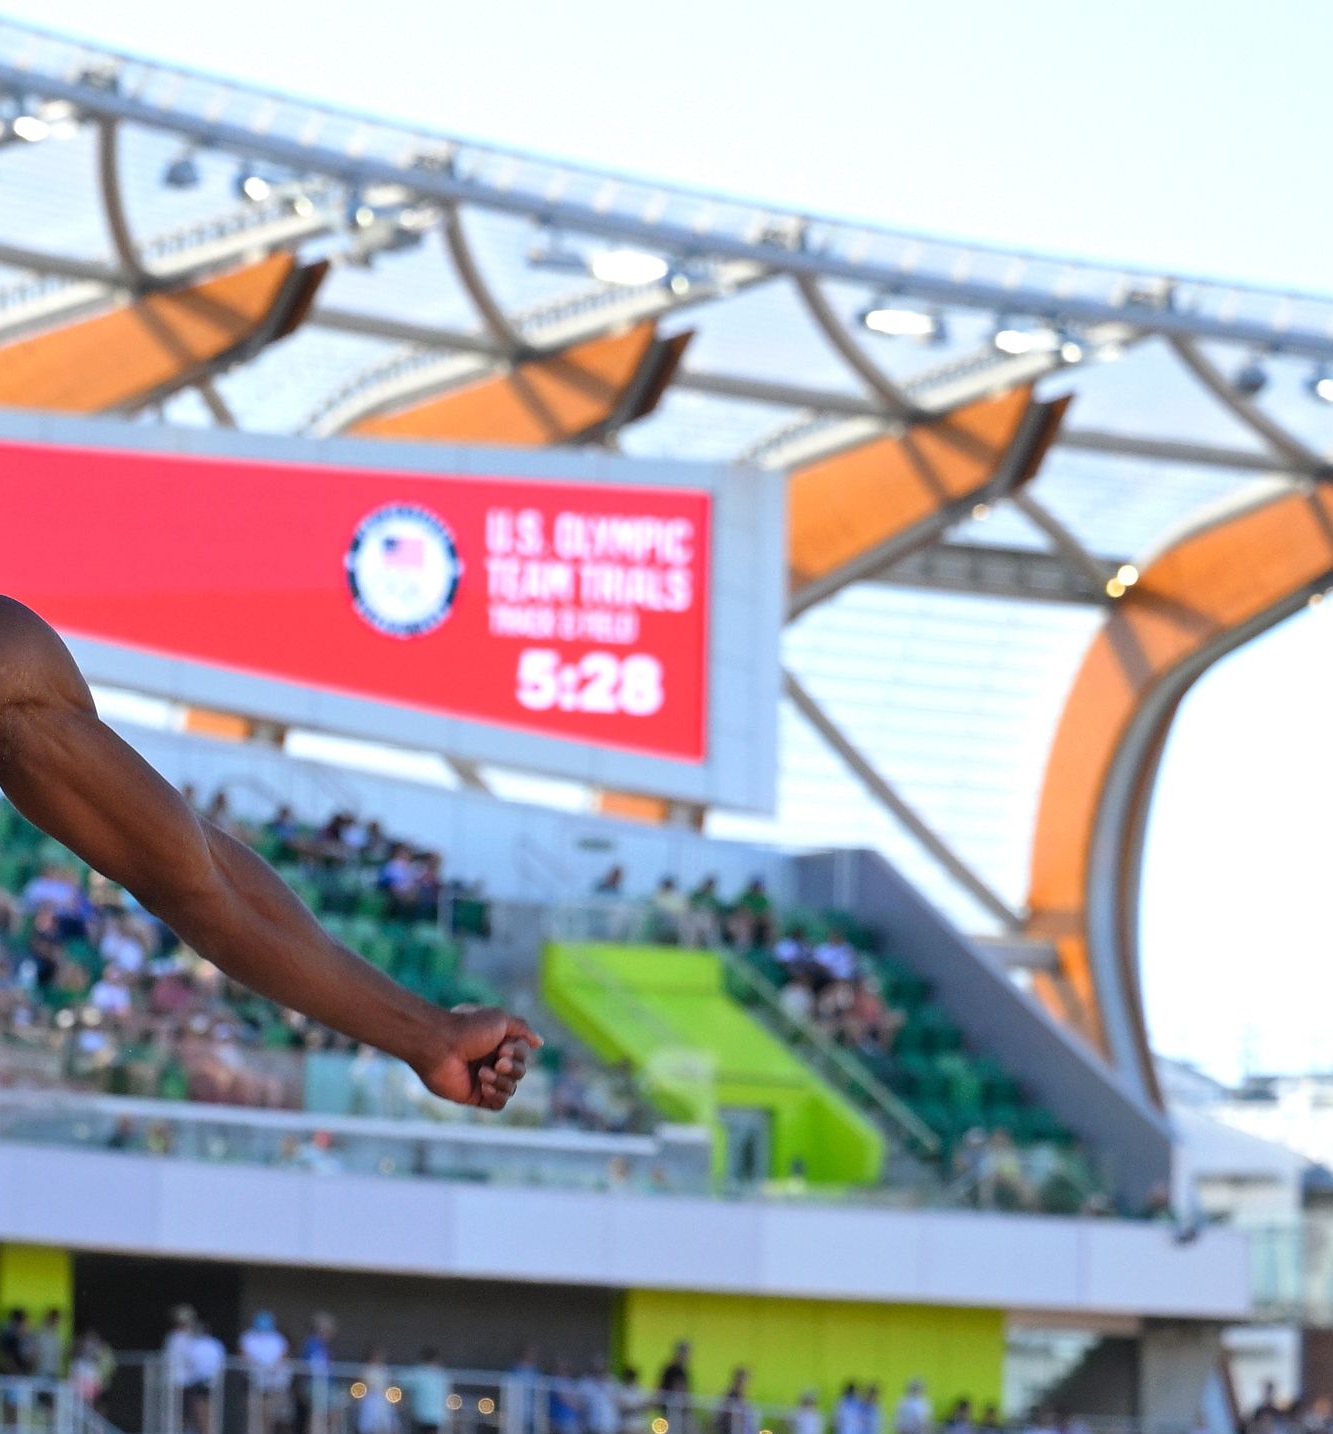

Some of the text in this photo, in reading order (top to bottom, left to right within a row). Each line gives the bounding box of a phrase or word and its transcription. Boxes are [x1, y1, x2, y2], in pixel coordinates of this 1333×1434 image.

[486, 508, 693, 565] U.S. OLYMPIC
[487, 556, 692, 612] TEAM TRIALS
[516, 648, 664, 716] 5:28
